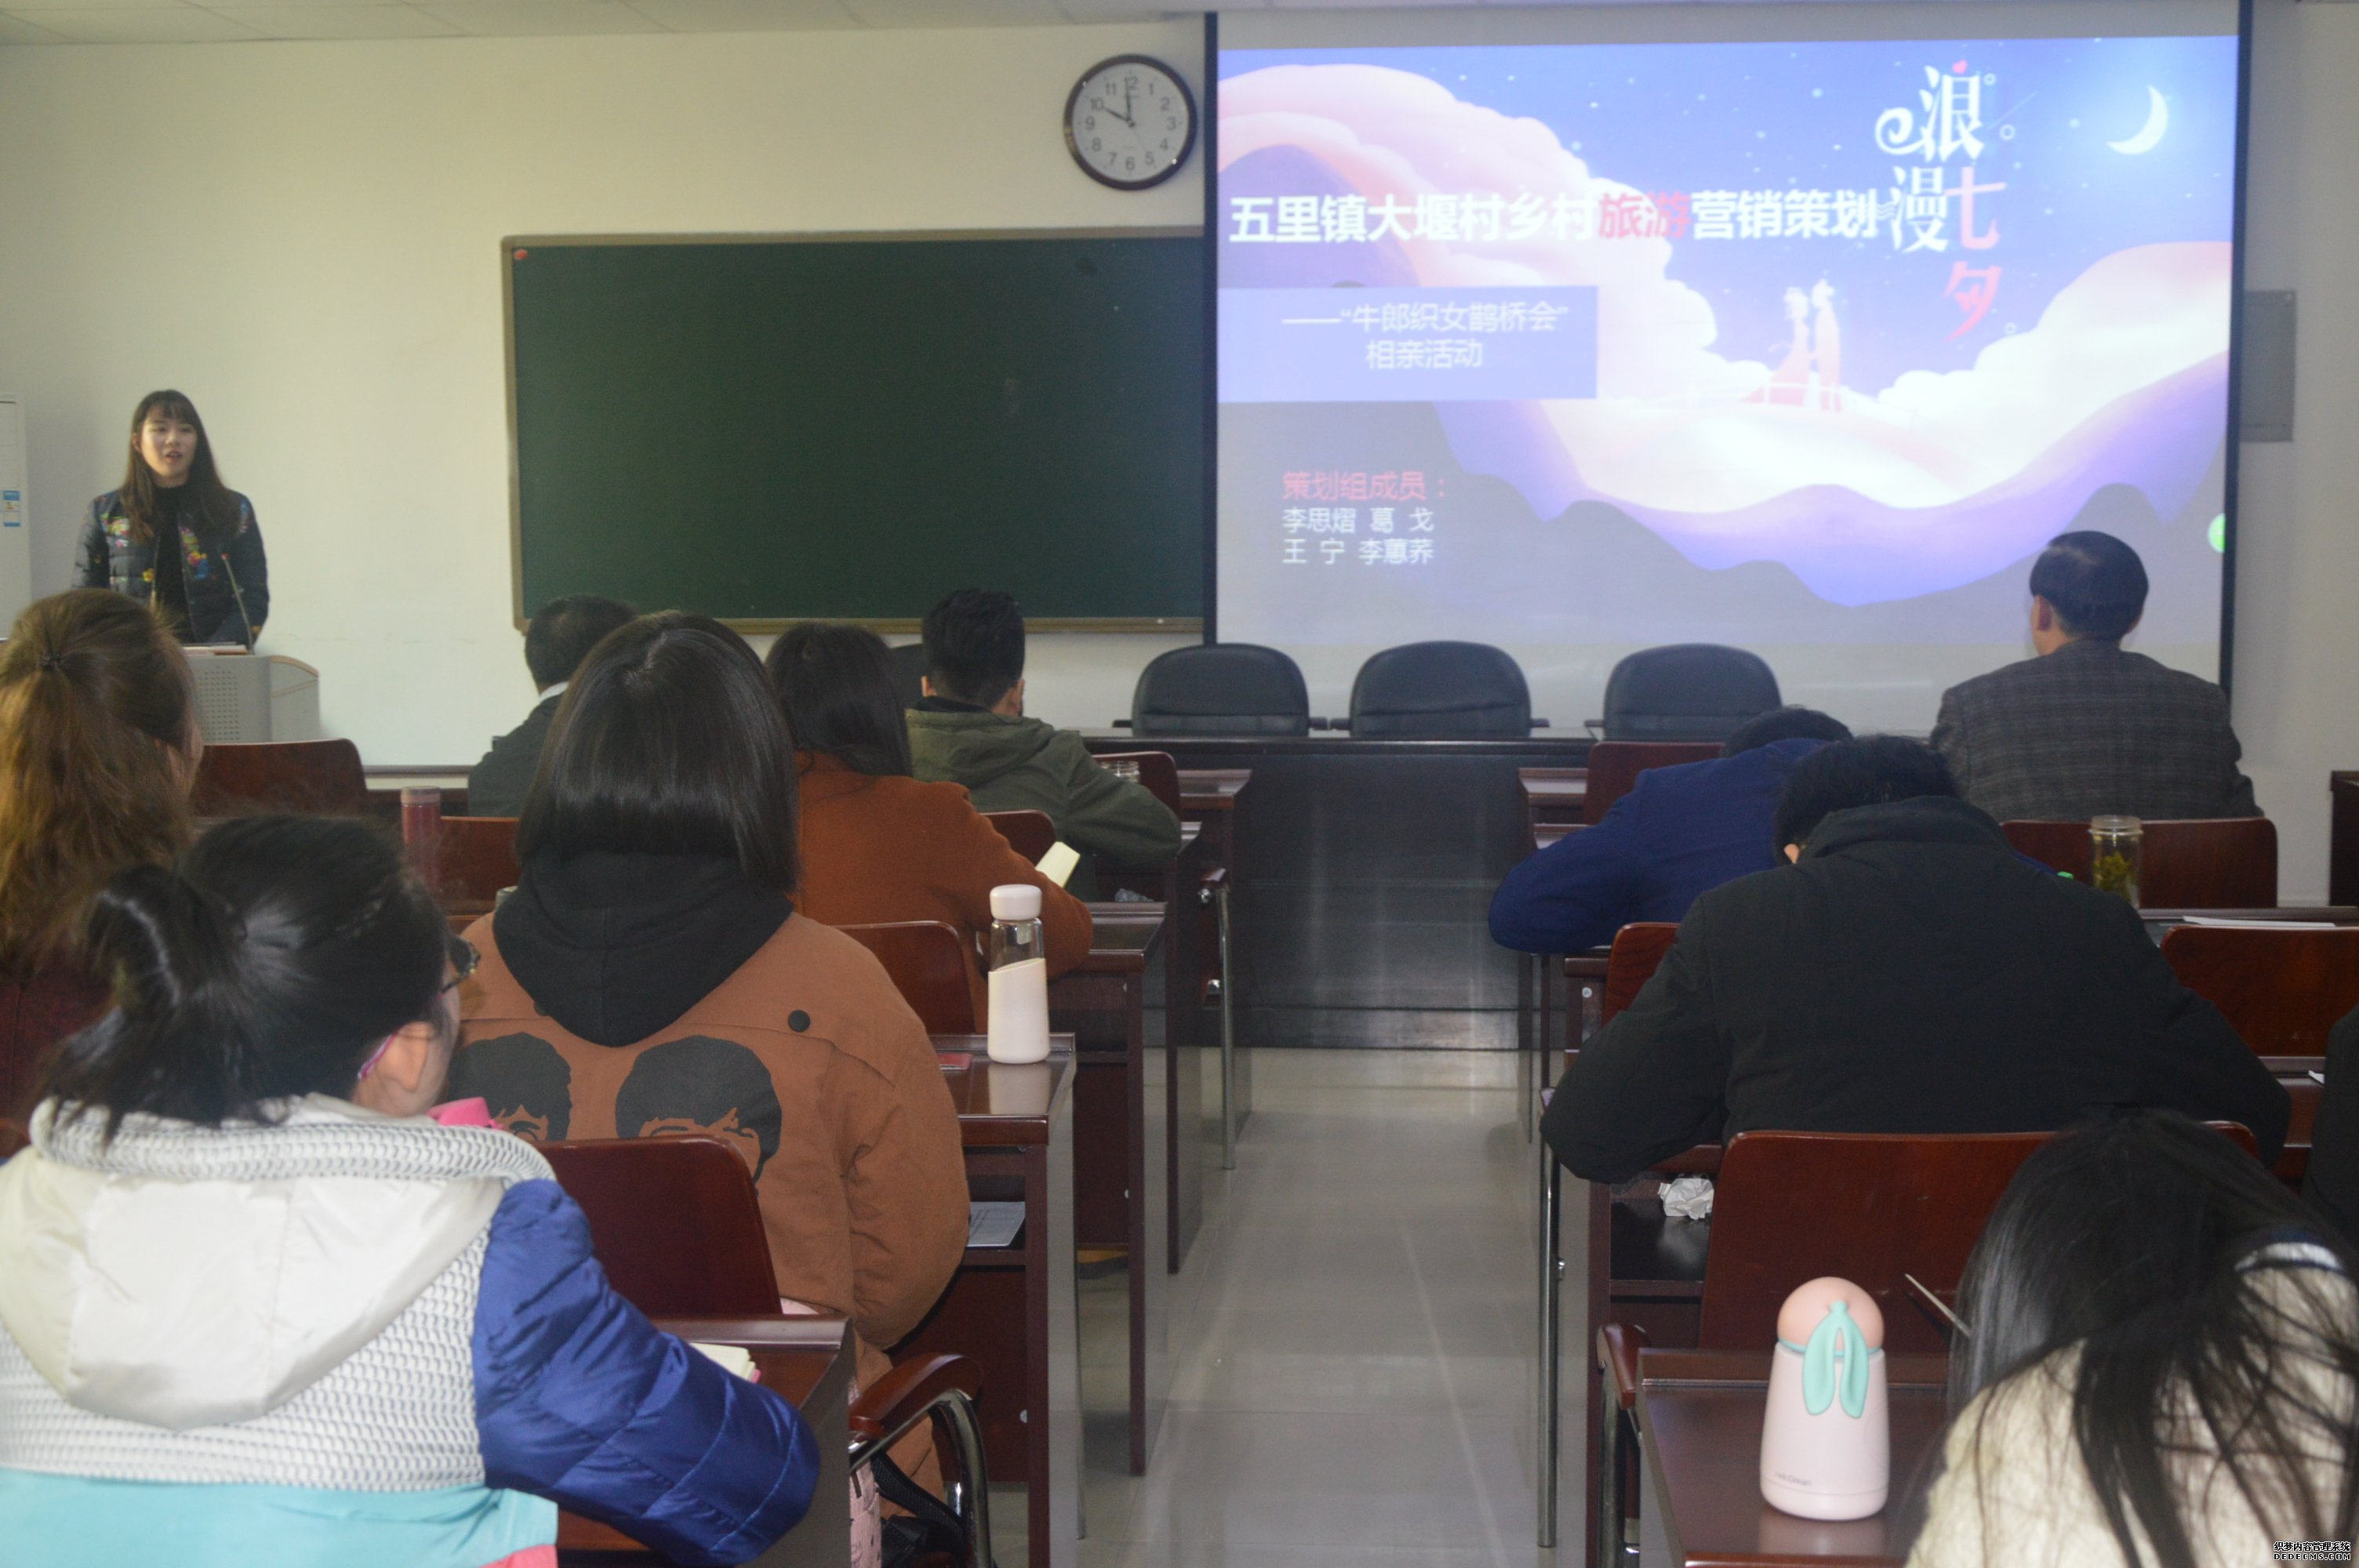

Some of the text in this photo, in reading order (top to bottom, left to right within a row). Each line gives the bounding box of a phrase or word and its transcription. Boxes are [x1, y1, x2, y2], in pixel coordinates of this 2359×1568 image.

[1106, 82, 1117, 95] 11
[1125, 76, 1139, 90] 12
[1149, 83, 1154, 95] 1
[1090, 99, 1104, 111] 10
[1161, 97, 1170, 111] 2
[1086, 117, 1096, 130] 9
[1167, 117, 1176, 130] 3
[1092, 138, 1102, 151] 8
[1160, 139, 1169, 151] 4
[1109, 152, 1118, 165] 7
[1126, 157, 1136, 170] 6
[1146, 152, 1155, 165] 5
[1229, 192, 1877, 244] 五里镇大堰村乡村旅游营销策划
[1365, 338, 1483, 370] 相亲活动
